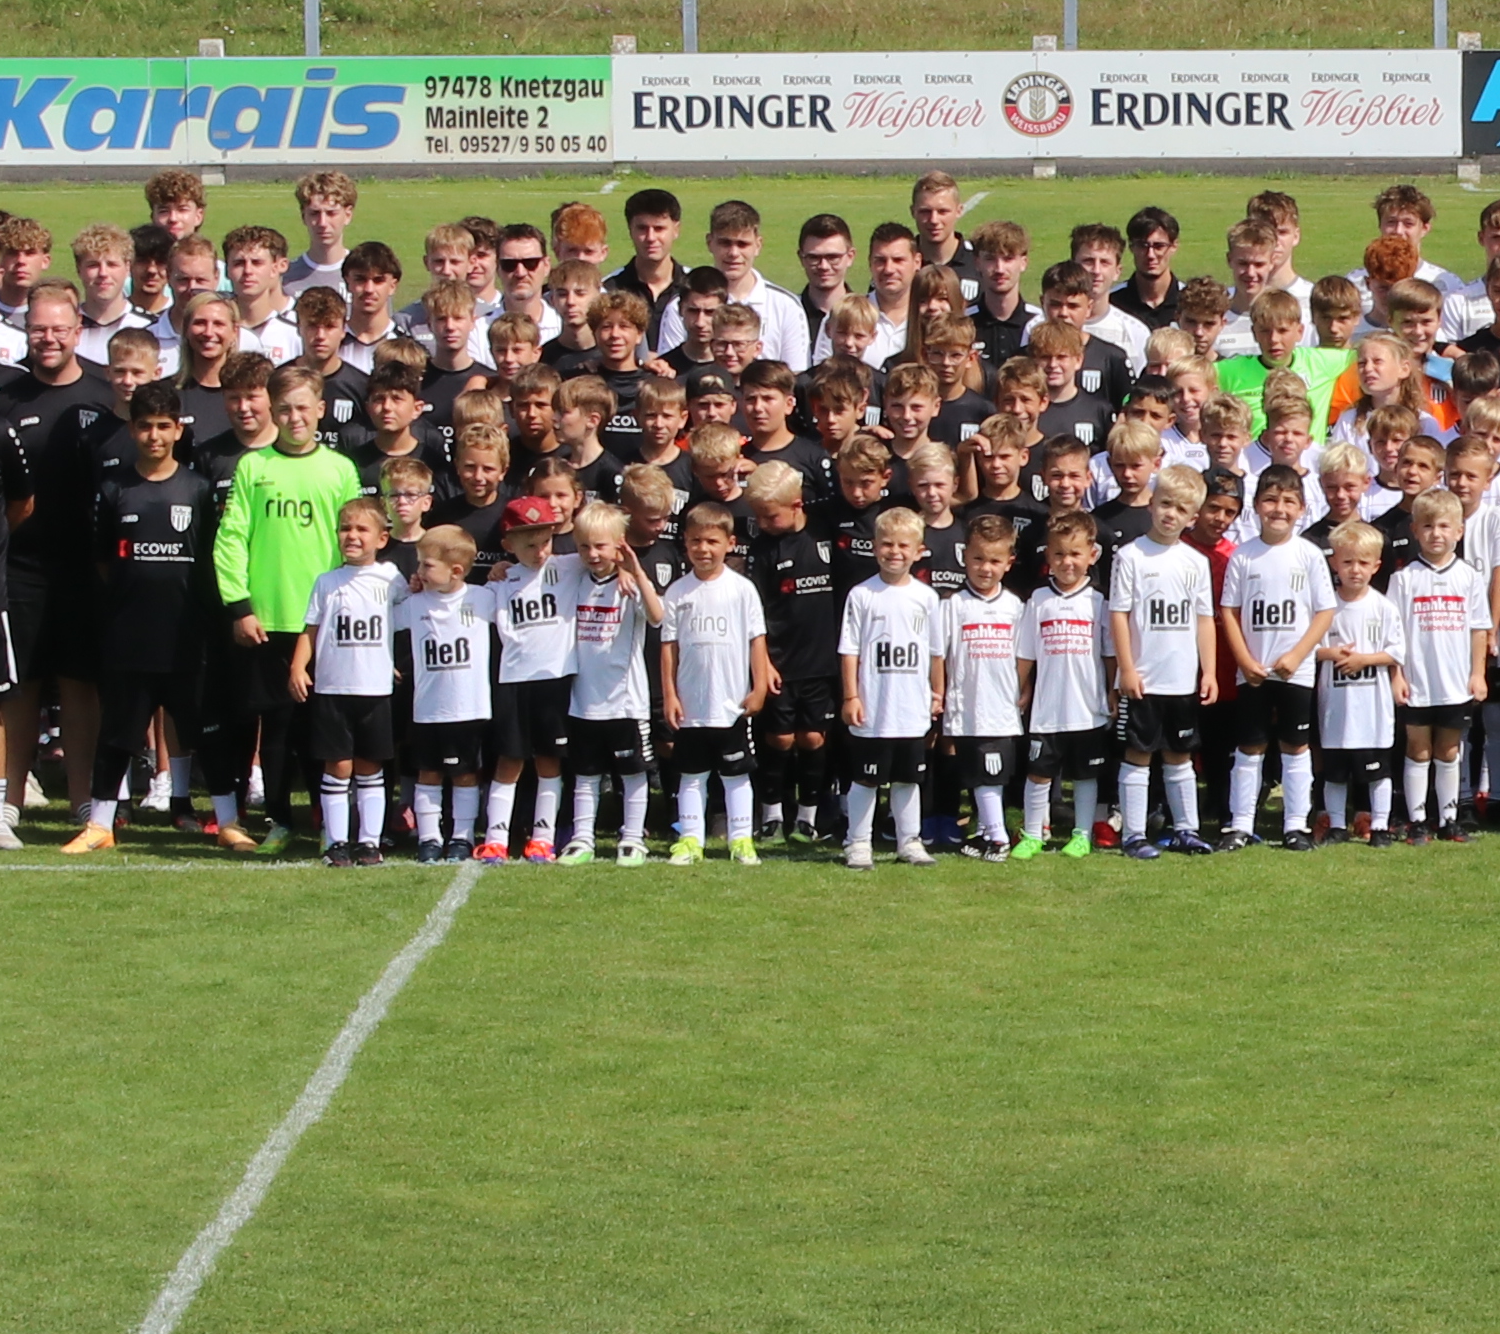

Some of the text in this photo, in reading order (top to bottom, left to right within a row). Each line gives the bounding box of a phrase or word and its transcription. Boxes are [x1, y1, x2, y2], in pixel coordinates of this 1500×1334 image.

[425, 76, 604, 102] 97478 Knetzgau
[641, 74, 973, 87] ERDINGER ERDINGER ERDINGER ERDINGER ERDINGER
[1007, 75, 1067, 101] ERDINGER
[425, 106, 548, 129] Mainleite 2
[632, 89, 986, 138] ERDINGER Weißbier
[1090, 88, 1444, 135] ERDINGER Weißbier
[425, 135, 607, 155] Tel. 09527/9 50 05 40
[266, 493, 312, 527] ring
[511, 593, 556, 623] Heß
[337, 616, 382, 641] Heß
[690, 613, 728, 637] ring
[426, 638, 470, 665] Heß
[877, 642, 919, 667] Heß
